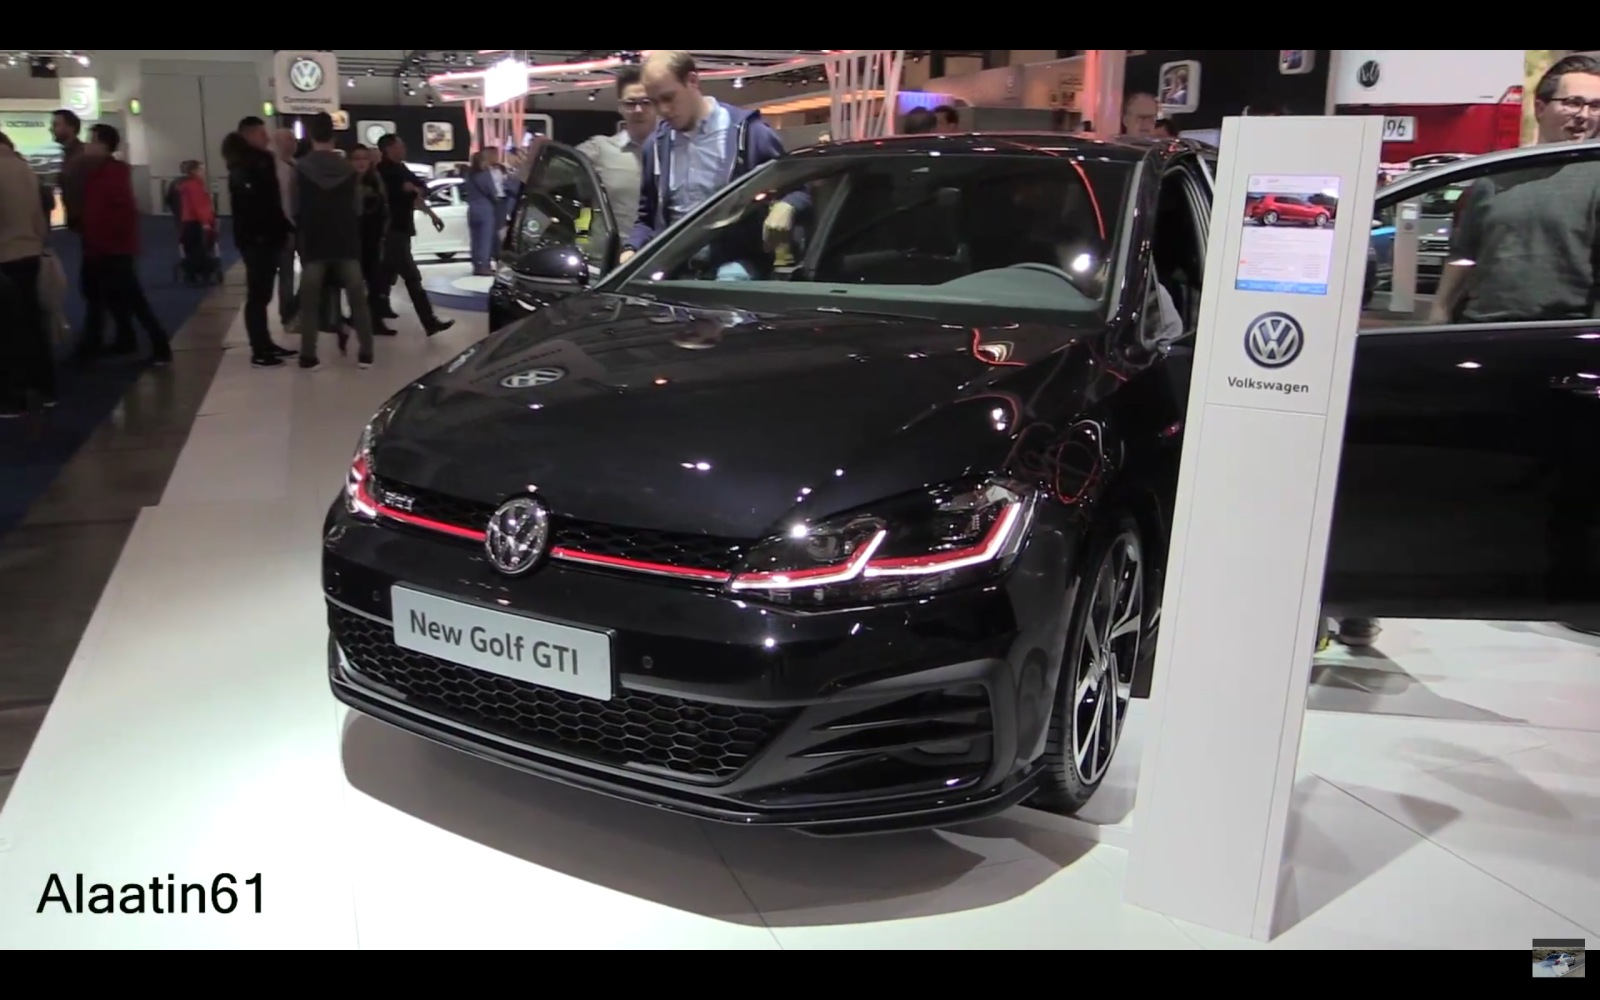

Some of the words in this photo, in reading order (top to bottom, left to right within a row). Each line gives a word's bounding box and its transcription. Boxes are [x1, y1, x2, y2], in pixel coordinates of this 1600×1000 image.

[1228, 376, 1309, 394] Volkswagen
[410, 609, 462, 646] New
[470, 626, 524, 662] Golf
[533, 641, 578, 675] GTI
